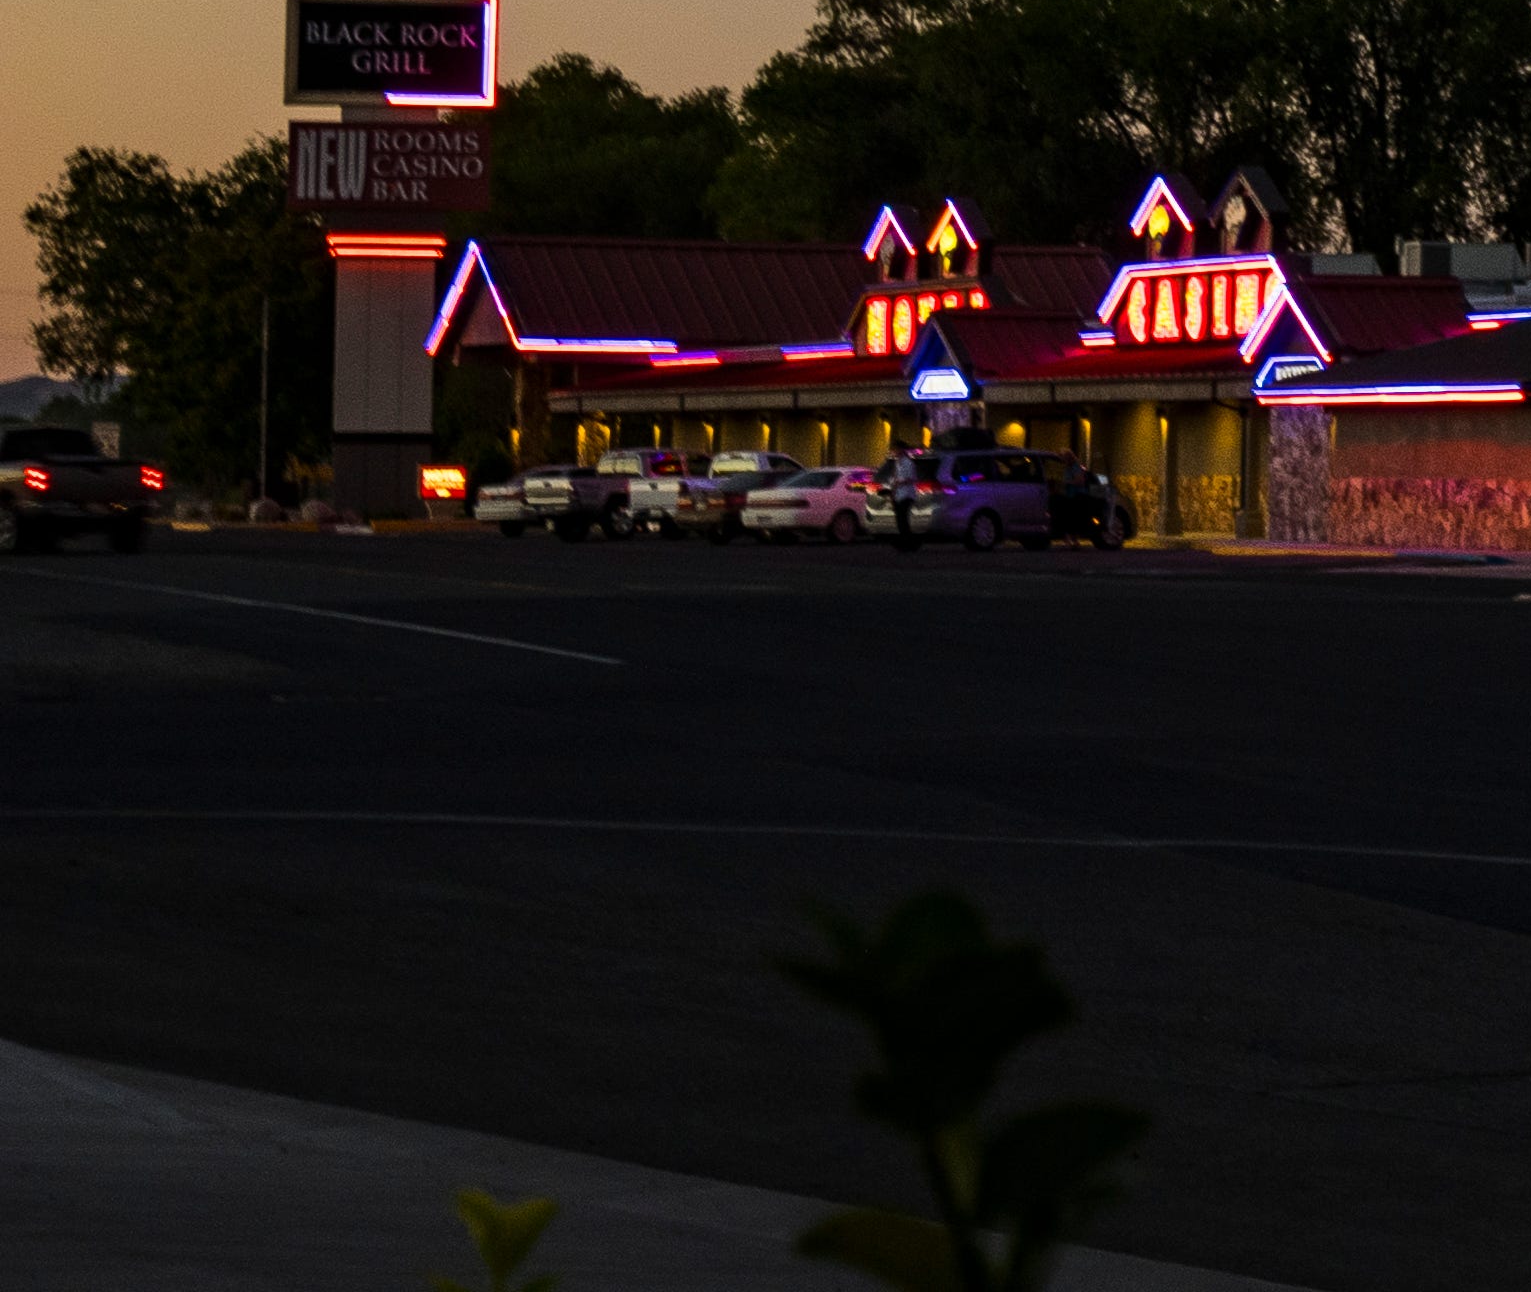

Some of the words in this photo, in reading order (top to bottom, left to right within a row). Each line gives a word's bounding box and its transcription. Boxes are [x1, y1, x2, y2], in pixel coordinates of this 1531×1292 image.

[305, 20, 393, 46] BLACK
[401, 21, 478, 48] ROCK
[351, 49, 431, 75] GRILL
[372, 129, 480, 153] ROOMS
[297, 127, 368, 200] NEW
[372, 154, 485, 180] CASINO
[372, 179, 430, 202] BAR
